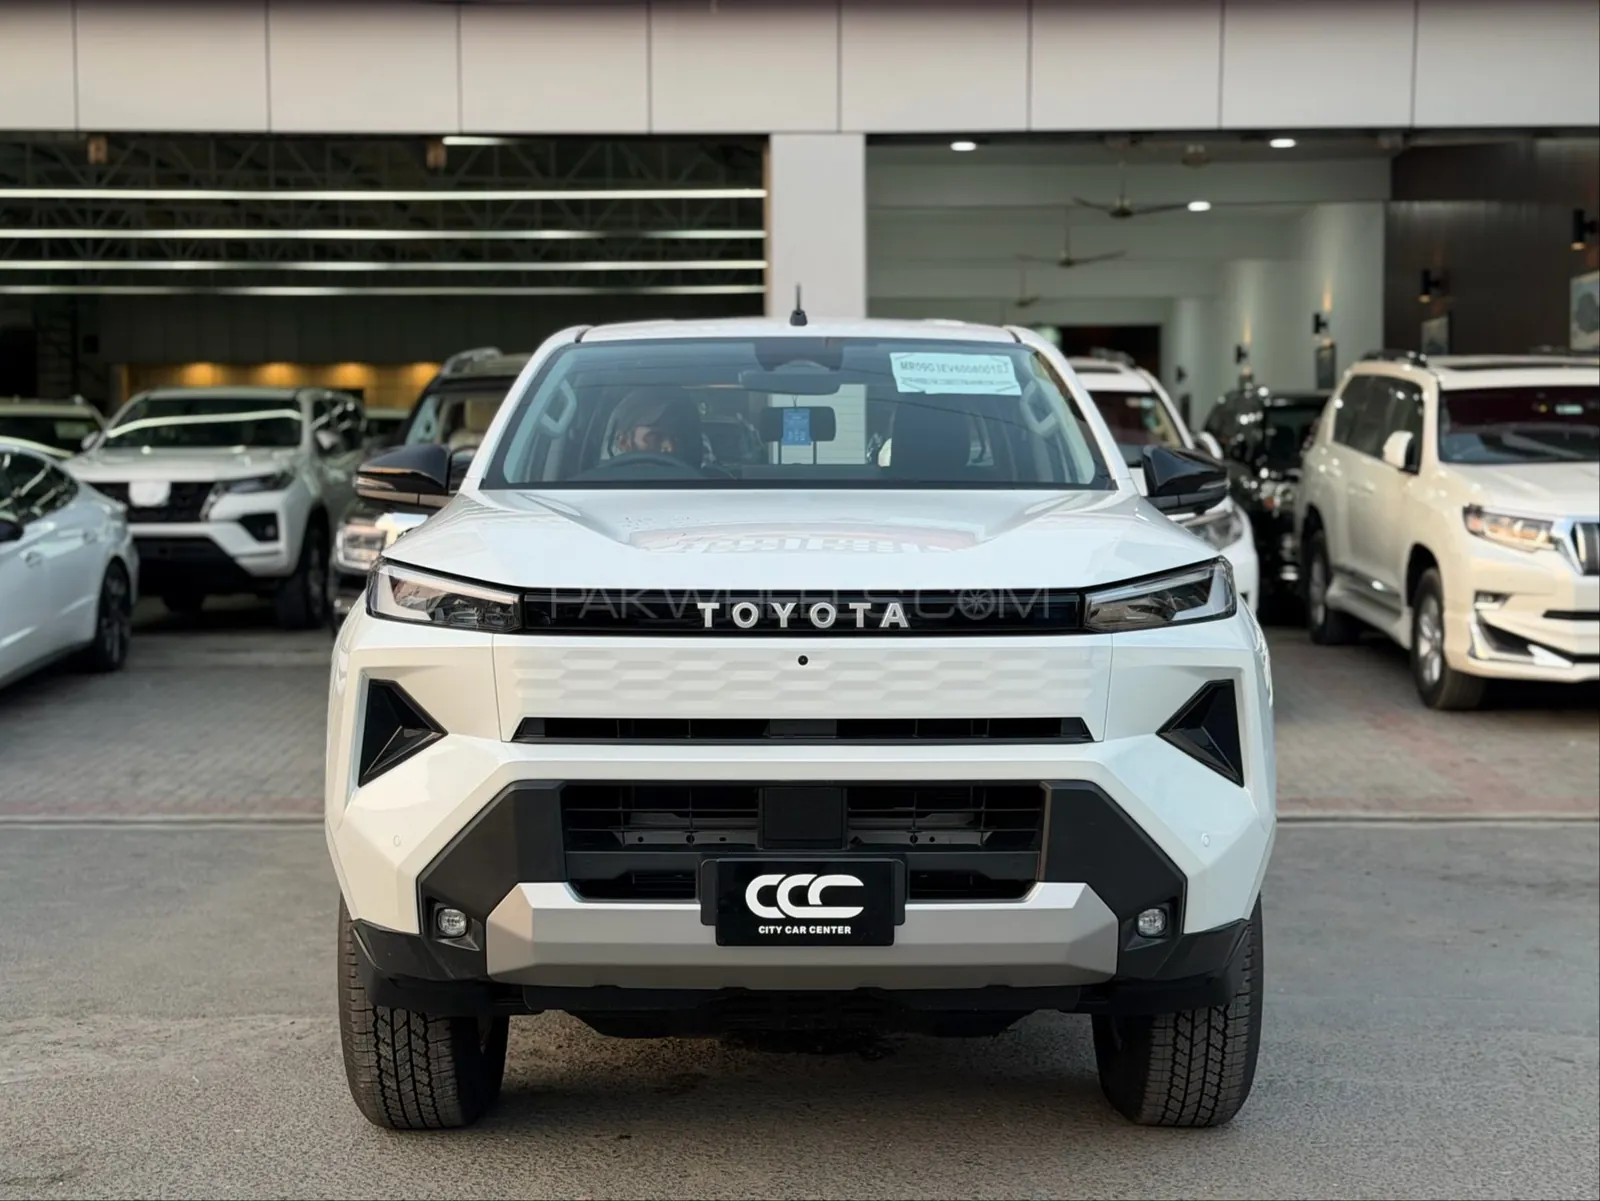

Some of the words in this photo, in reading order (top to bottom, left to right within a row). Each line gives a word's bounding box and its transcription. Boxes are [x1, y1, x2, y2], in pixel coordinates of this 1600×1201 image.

[697, 602, 910, 628] TOYOTA
[745, 874, 865, 919] CCC
[758, 925, 783, 935] CITY
[784, 925, 807, 935] CAR
[809, 925, 852, 935] CENTER
